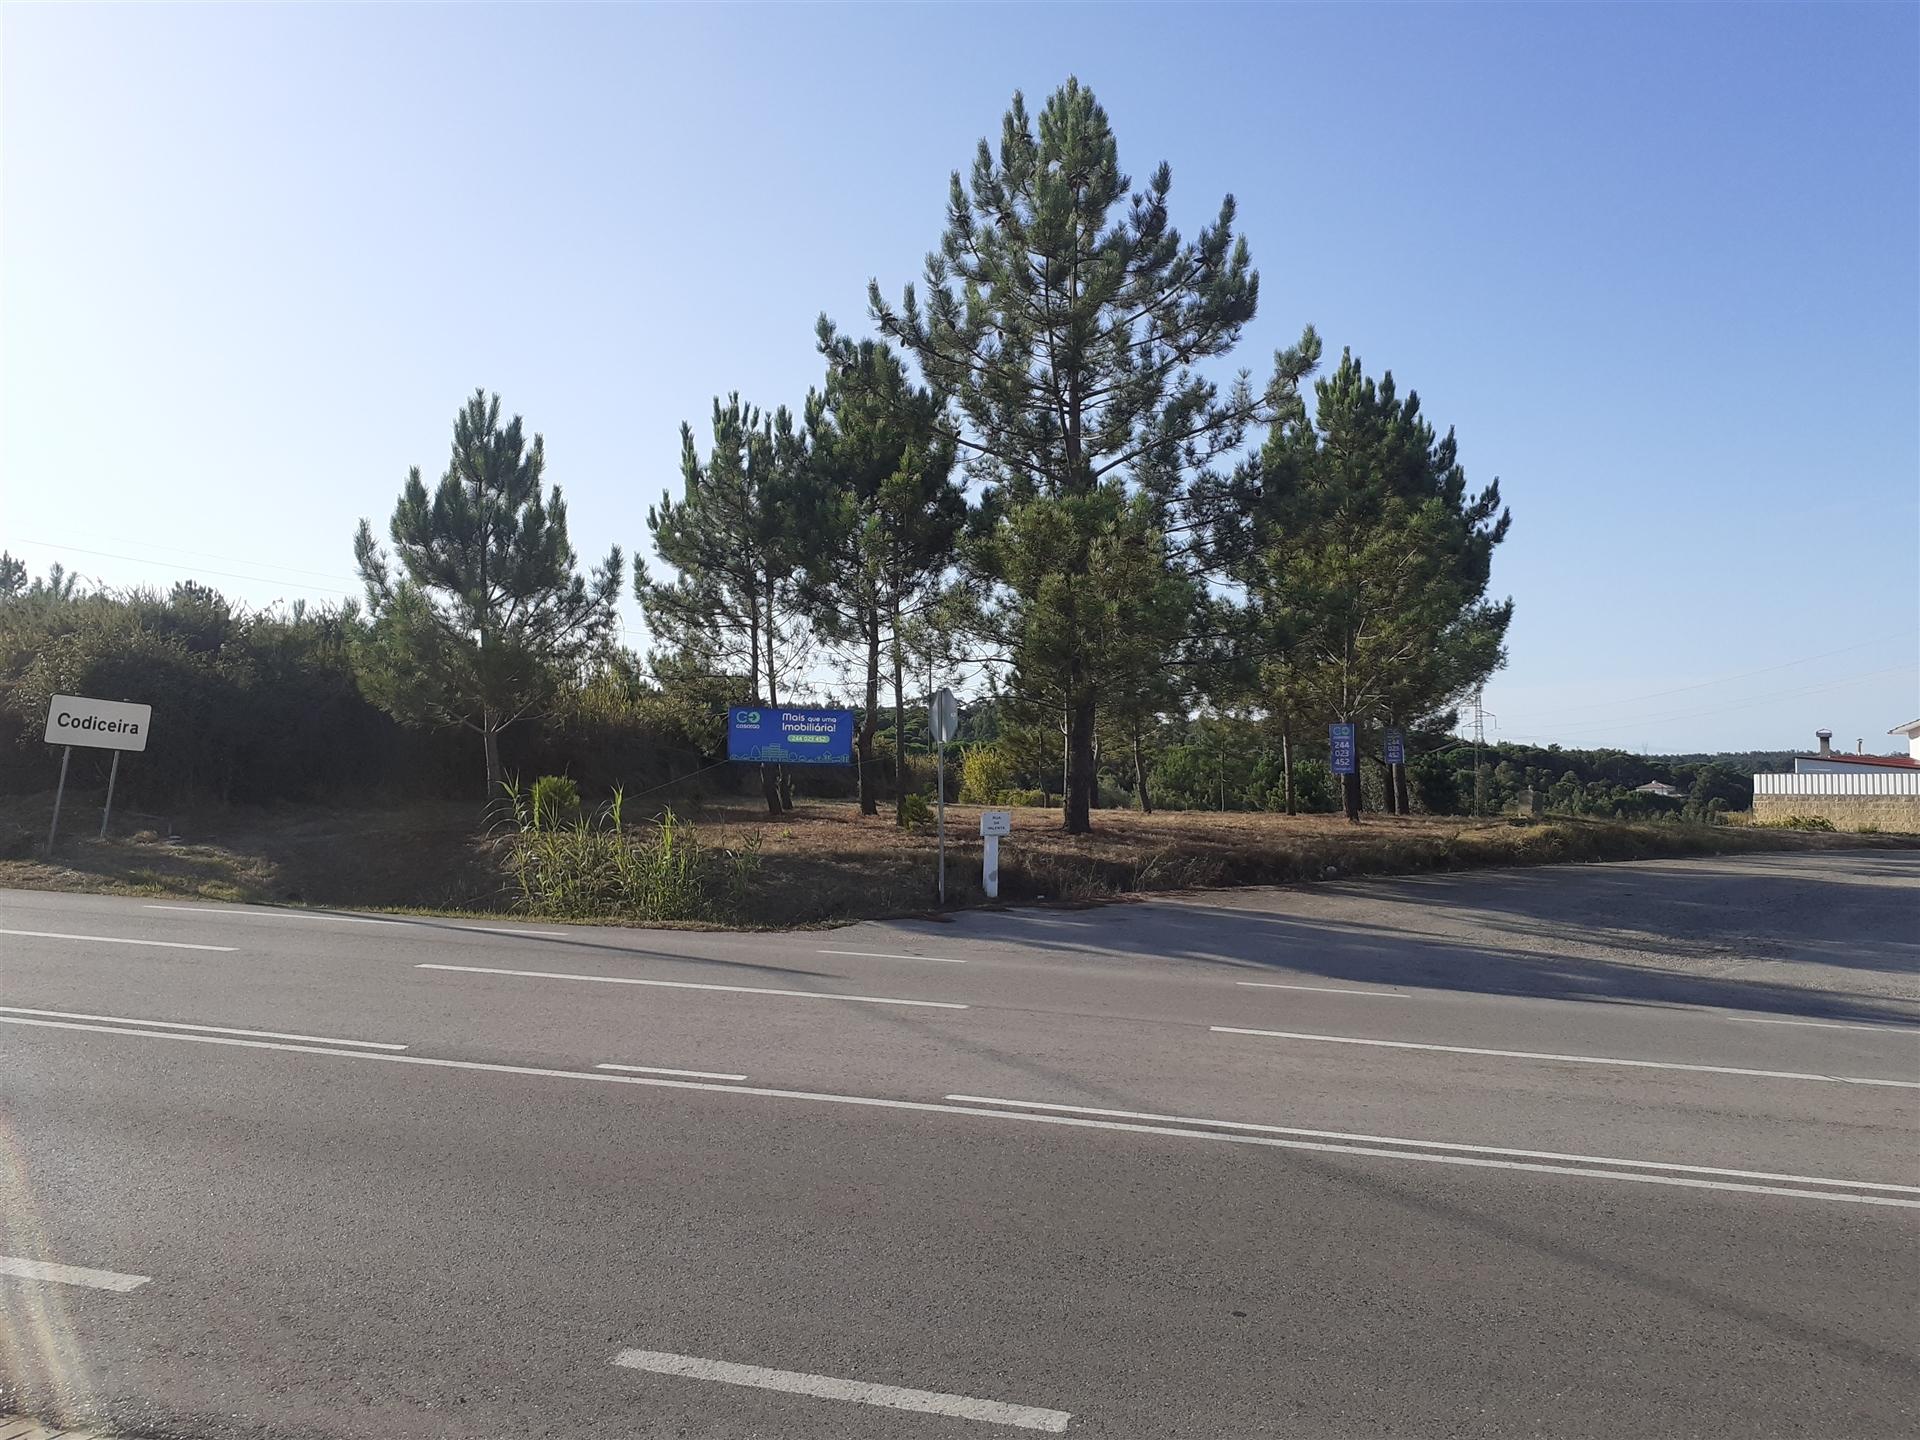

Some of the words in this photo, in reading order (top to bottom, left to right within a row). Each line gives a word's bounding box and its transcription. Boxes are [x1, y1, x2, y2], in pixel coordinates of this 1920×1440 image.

[782, 713, 805, 722] Mais
[57, 712, 139, 735] Codiceira
[782, 722, 836, 732] Imobiliária!
[1334, 741, 1350, 749] 244
[1335, 758, 1350, 766] 452
